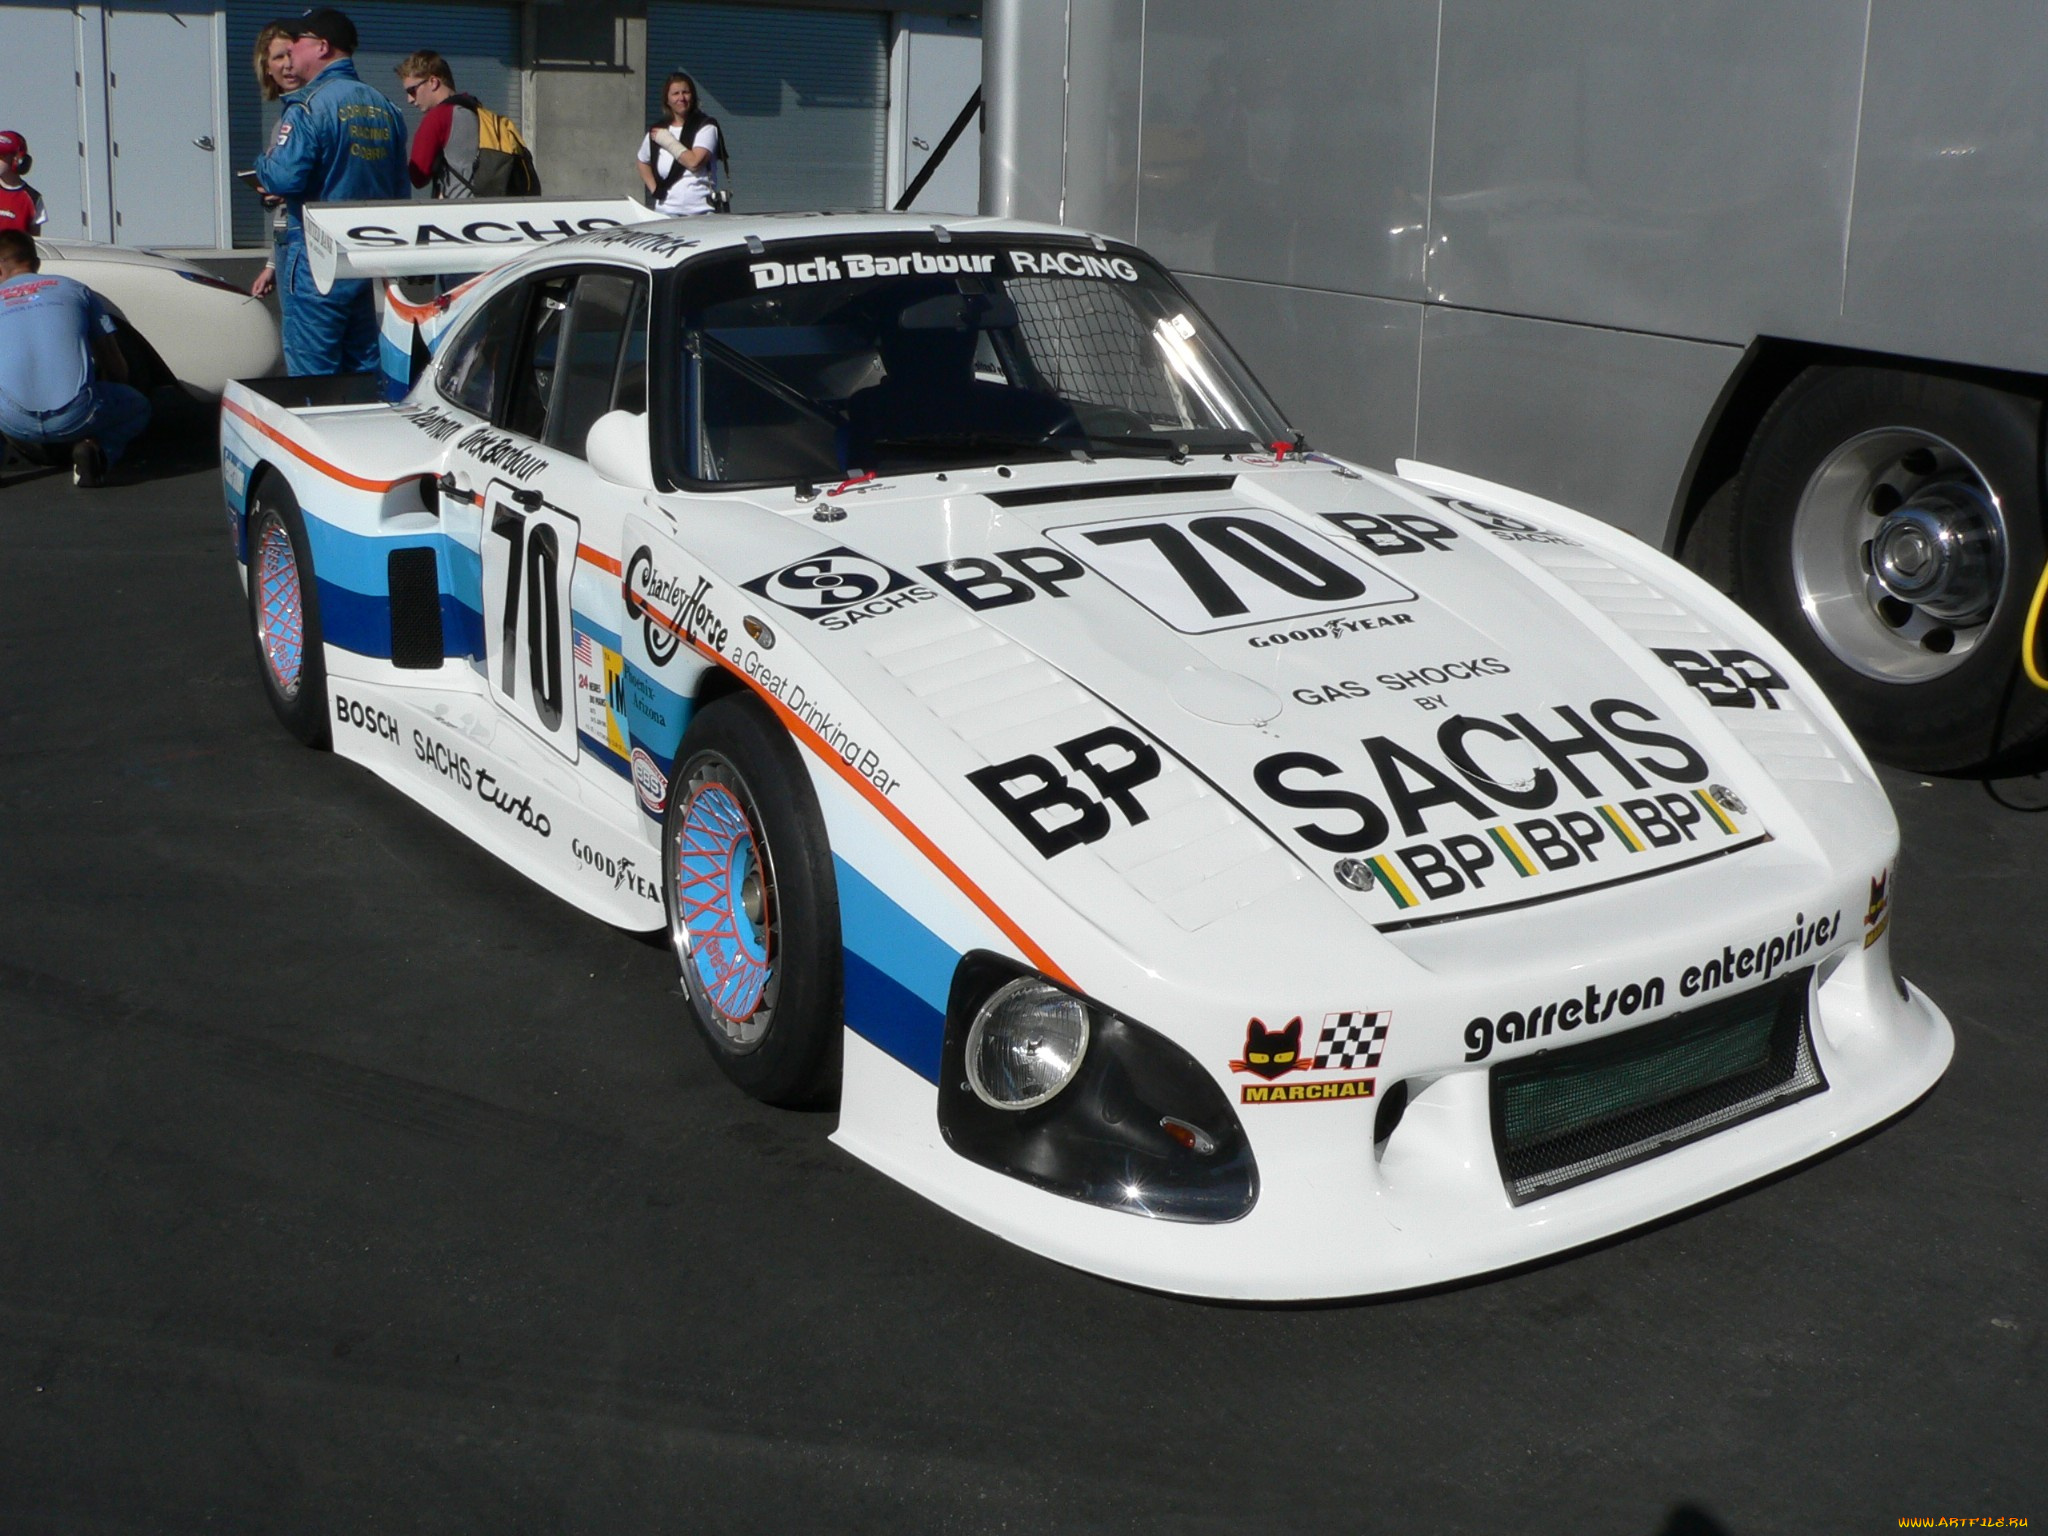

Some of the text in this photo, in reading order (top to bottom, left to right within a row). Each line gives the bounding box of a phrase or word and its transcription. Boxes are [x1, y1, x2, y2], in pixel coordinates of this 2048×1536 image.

[351, 124, 390, 140] RACING
[748, 250, 1139, 289] Dick Barbour RACING
[457, 427, 549, 482] Dick Barbour
[1316, 511, 1459, 556] BP
[1490, 530, 1585, 548] SACHS
[915, 546, 1086, 612] BP
[1080, 516, 1367, 618] 70
[490, 500, 563, 733] 70
[675, 574, 728, 653] Horse
[818, 584, 940, 632] SACHS
[1247, 613, 1415, 649] GOODYEAR
[578, 673, 589, 690] 24
[1292, 655, 1511, 707] GAS SHOCKS
[1415, 695, 1449, 712] BY
[1648, 647, 1790, 710] BP
[633, 693, 667, 727] Arizona
[732, 646, 901, 796] a Great Drinking Bar
[335, 694, 552, 838] BOSCH SACHS turbo
[964, 725, 1162, 861] BP
[1252, 698, 1709, 854] SACHS
[572, 837, 661, 904] GOODYEA
[1395, 788, 1702, 901] BP BP BP
[706, 937, 730, 980] BBS
[1463, 909, 1841, 1063] garretson enterprises
[1245, 1081, 1370, 1102] MARCHAL
